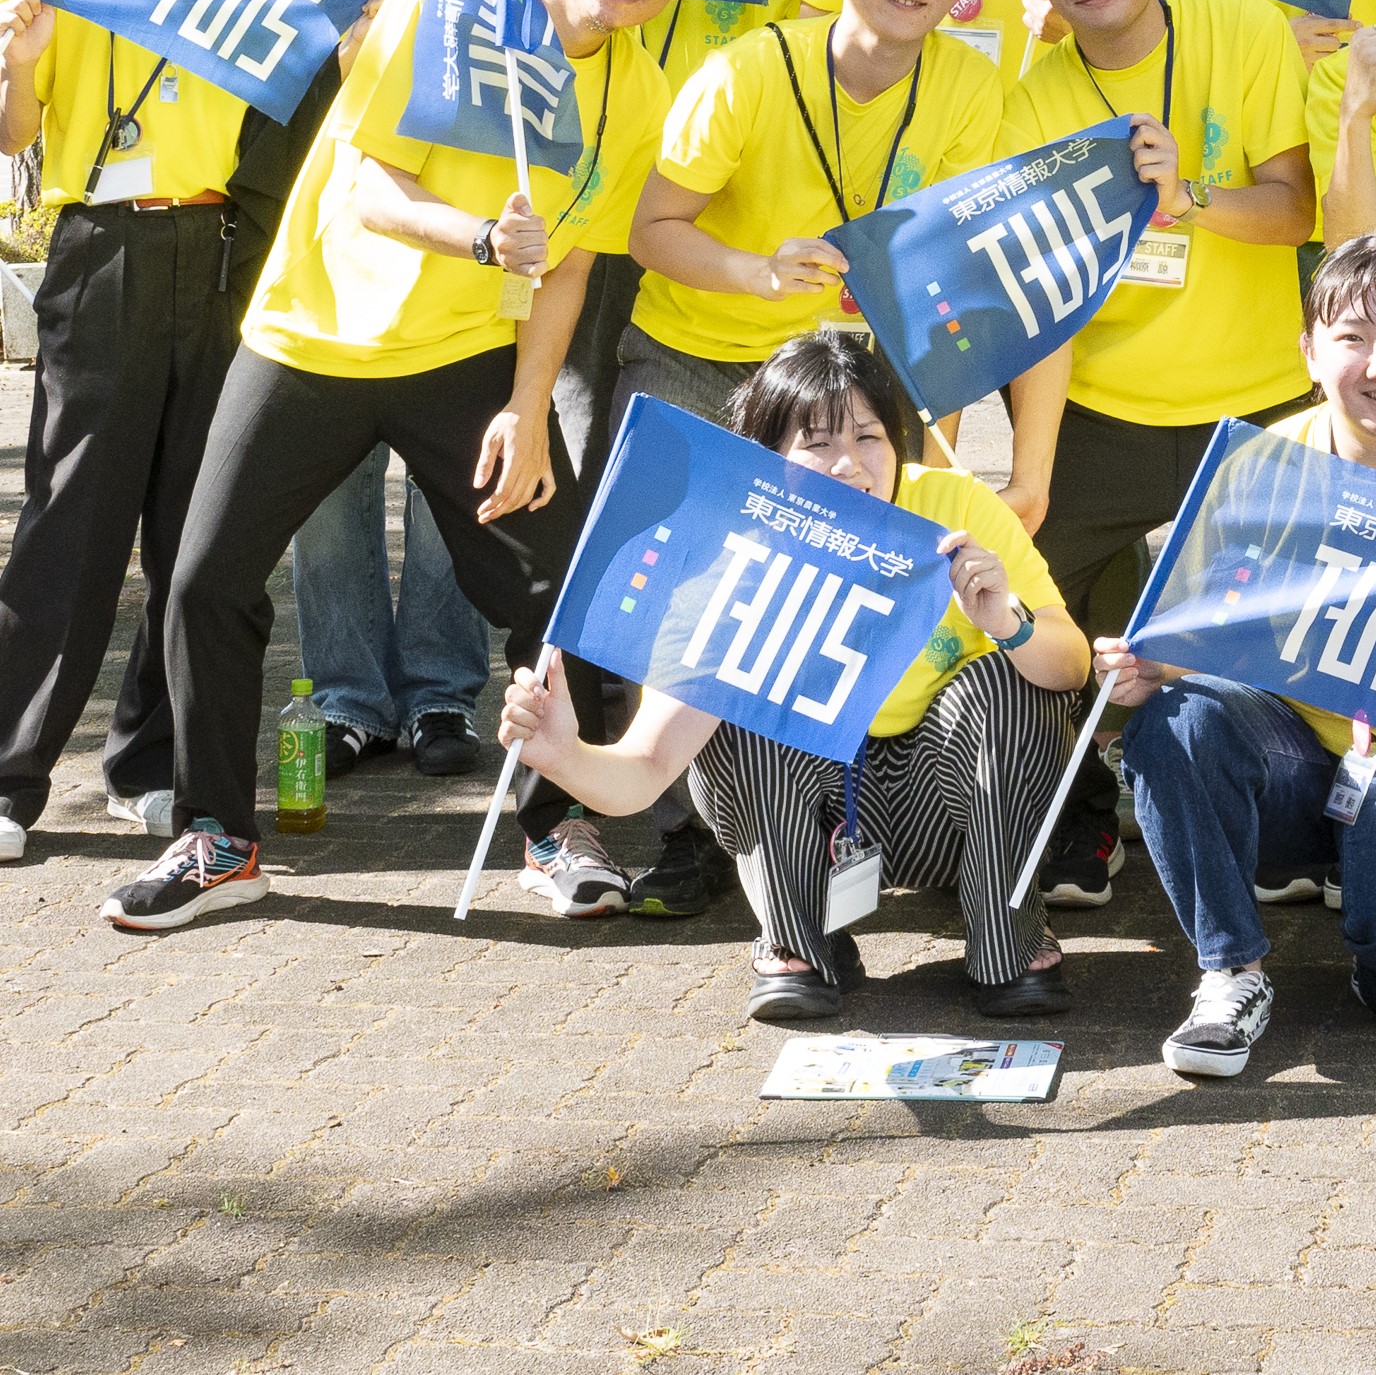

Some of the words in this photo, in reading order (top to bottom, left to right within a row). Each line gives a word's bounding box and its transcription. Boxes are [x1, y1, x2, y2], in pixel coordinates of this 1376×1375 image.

[949, 137, 1097, 225] 東京情報大学
[966, 165, 1132, 339] TUIS
[1144, 242, 1178, 257] STAFF
[740, 491, 914, 578] 東京情報大学
[680, 531, 896, 725] TUIS
